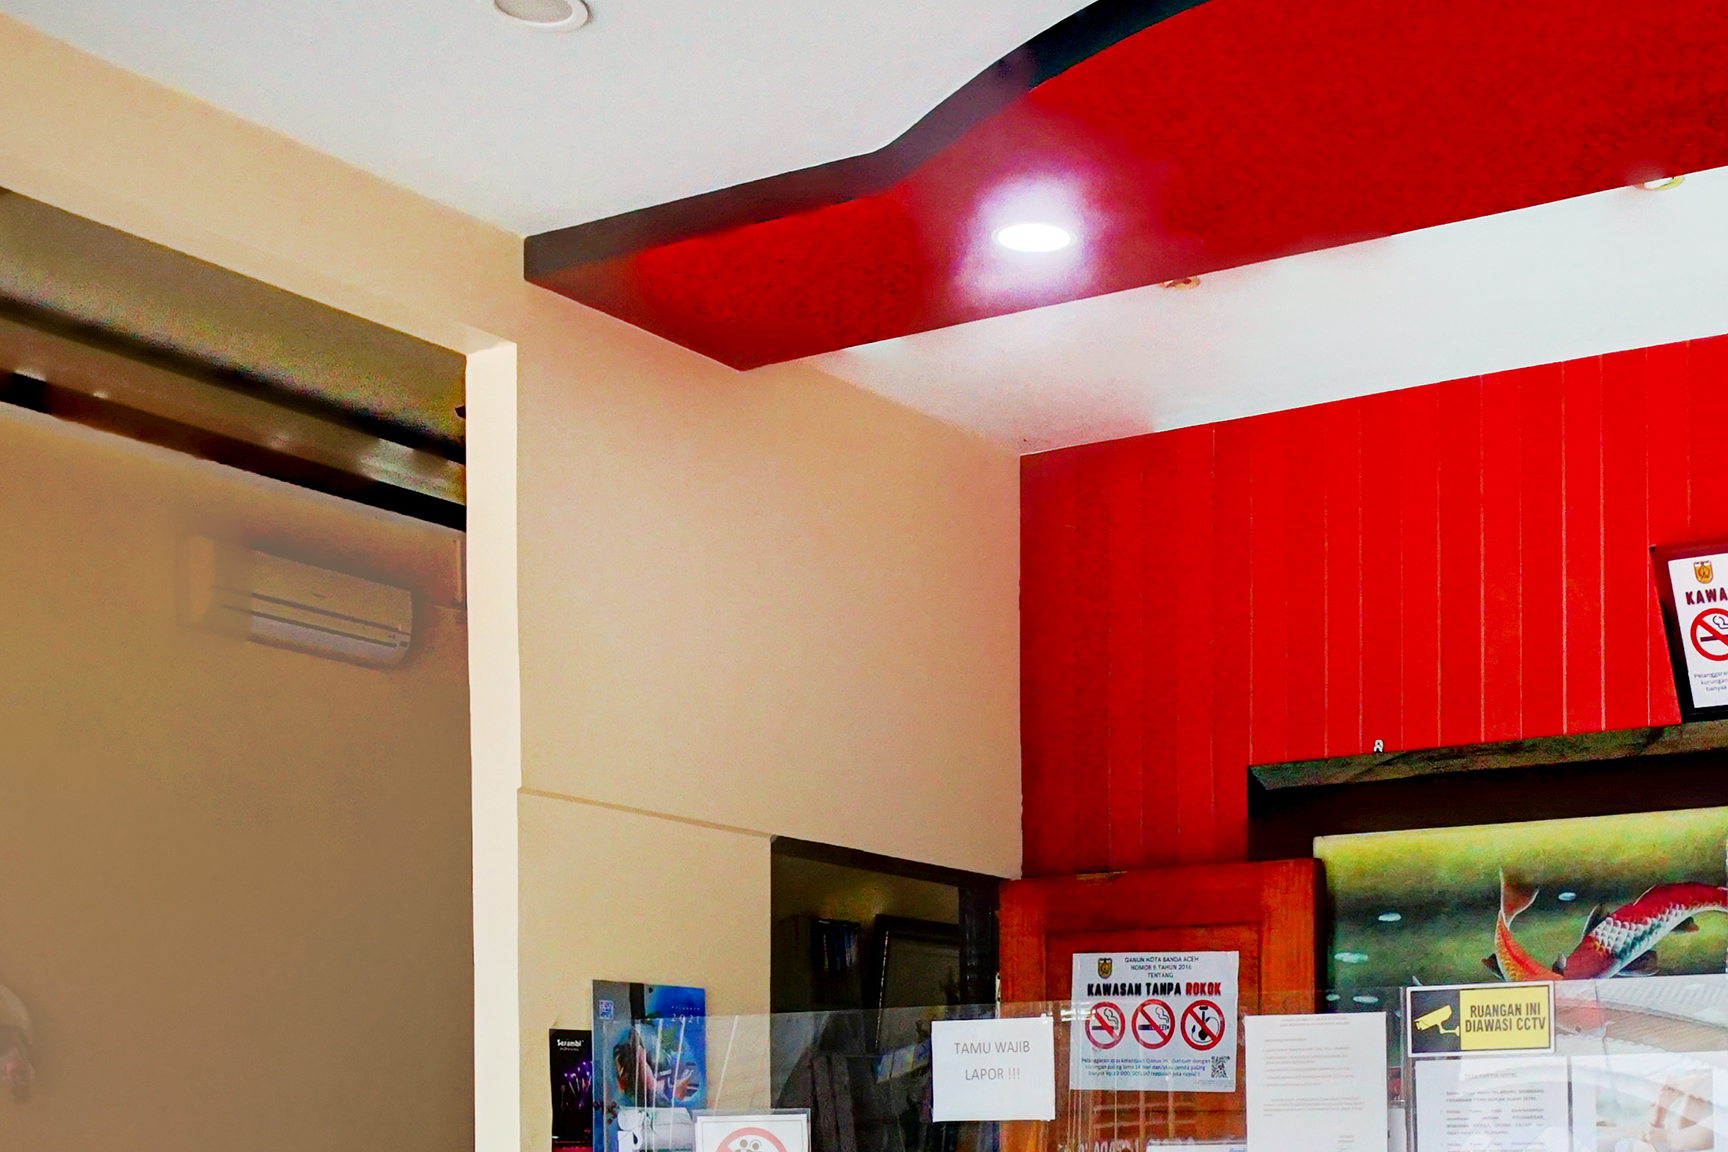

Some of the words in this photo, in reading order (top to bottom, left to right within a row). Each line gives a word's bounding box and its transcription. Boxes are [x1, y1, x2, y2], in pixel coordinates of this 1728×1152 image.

[1088, 983, 1142, 996] KAWASAN
[1146, 983, 1181, 996] TANPA
[1186, 982, 1221, 996] ROKOK
[1470, 1004, 1522, 1017] RUANGAN
[1526, 1003, 1541, 1015] INI
[1465, 1018, 1513, 1033] DIAWASI
[1516, 1016, 1545, 1031] CCTV
[954, 1041, 991, 1054] TAMU
[996, 1041, 1030, 1054] WAJIB
[964, 1067, 1004, 1081] LAPOR
